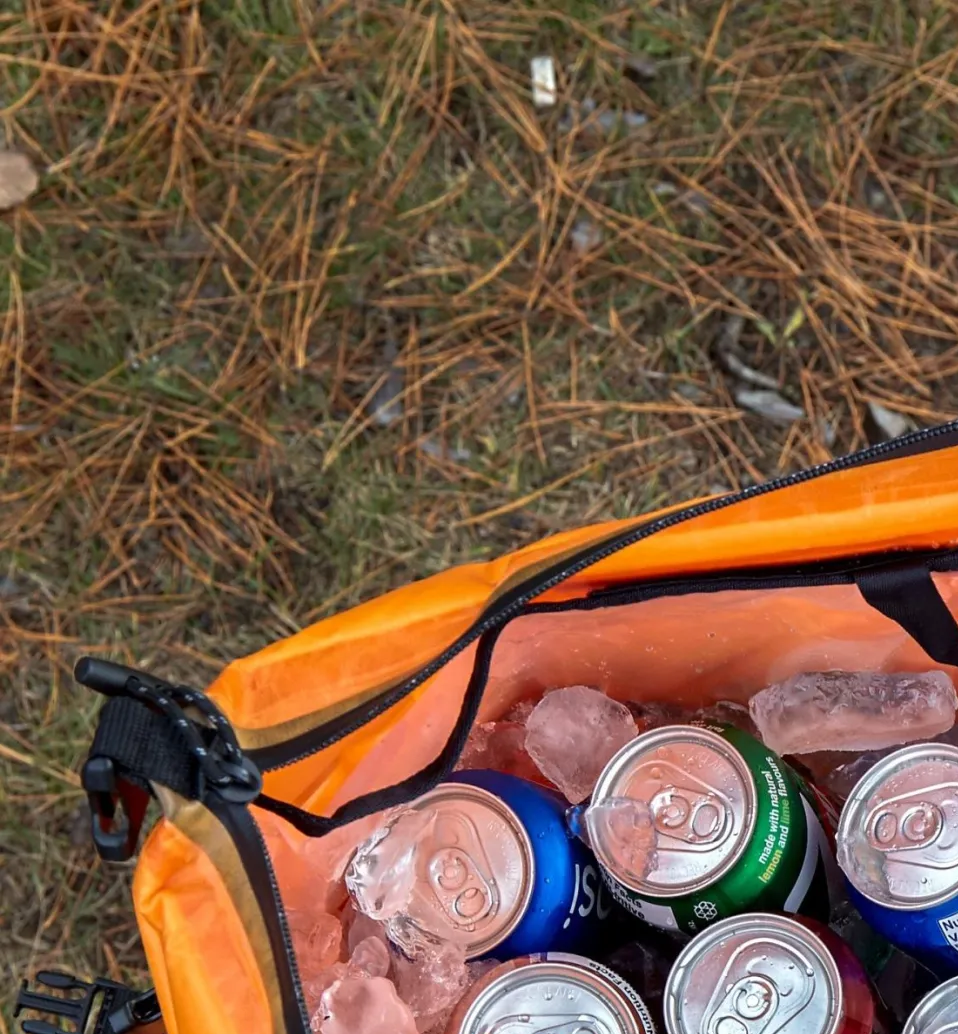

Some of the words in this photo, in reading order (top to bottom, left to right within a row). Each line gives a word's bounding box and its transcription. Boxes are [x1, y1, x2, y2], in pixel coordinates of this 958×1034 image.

[761, 770, 779, 808] natural
[769, 808, 780, 832] with
[780, 799, 790, 825] lime
[758, 832, 776, 864] made
[778, 825, 789, 849] and
[758, 849, 783, 884] lemon
